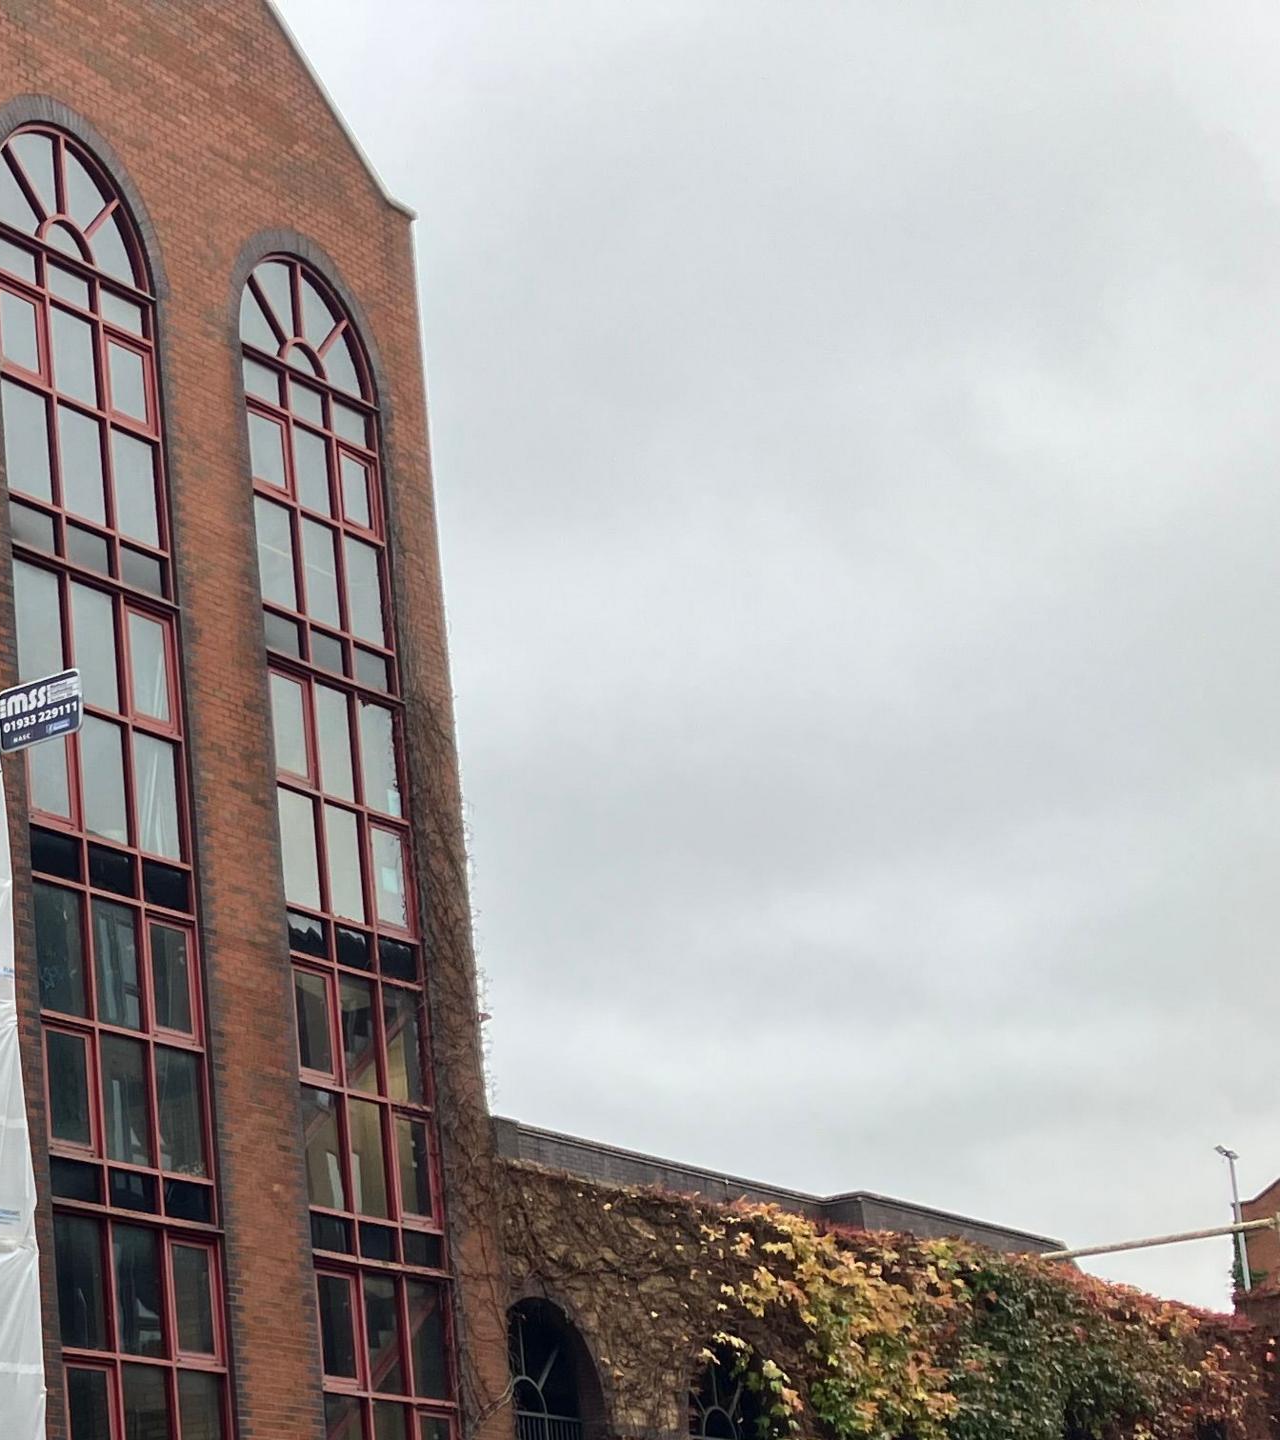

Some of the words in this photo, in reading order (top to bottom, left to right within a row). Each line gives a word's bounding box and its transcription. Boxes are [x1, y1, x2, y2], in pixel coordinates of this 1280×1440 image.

[3, 714, 36, 733] 01933
[38, 702, 77, 723] 229111
[13, 733, 31, 743] NASC
